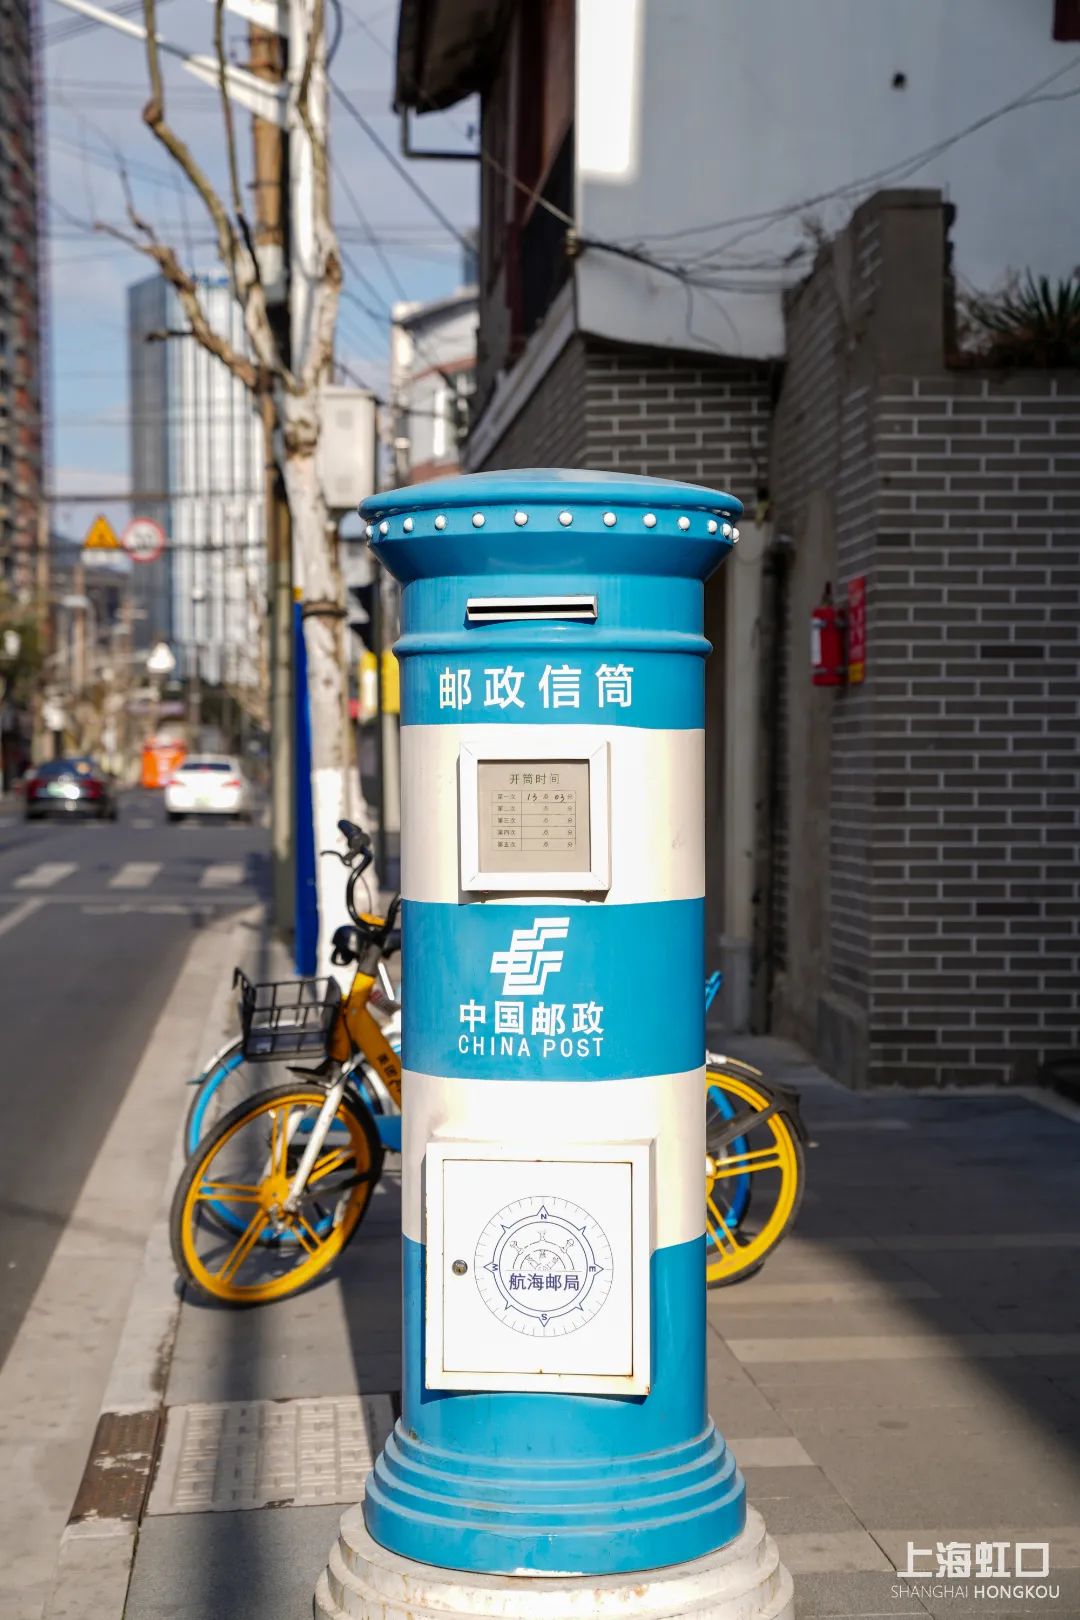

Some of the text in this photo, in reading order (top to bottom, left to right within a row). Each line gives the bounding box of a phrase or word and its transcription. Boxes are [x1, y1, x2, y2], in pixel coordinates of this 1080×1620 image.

[439, 663, 634, 709] 邮政信筒
[510, 773, 560, 784] 开筒时间
[459, 999, 604, 1037] 中国邮政
[458, 1034, 604, 1058] CHINA POST
[509, 1273, 580, 1291] 航海邮局
[541, 1313, 548, 1321] S
